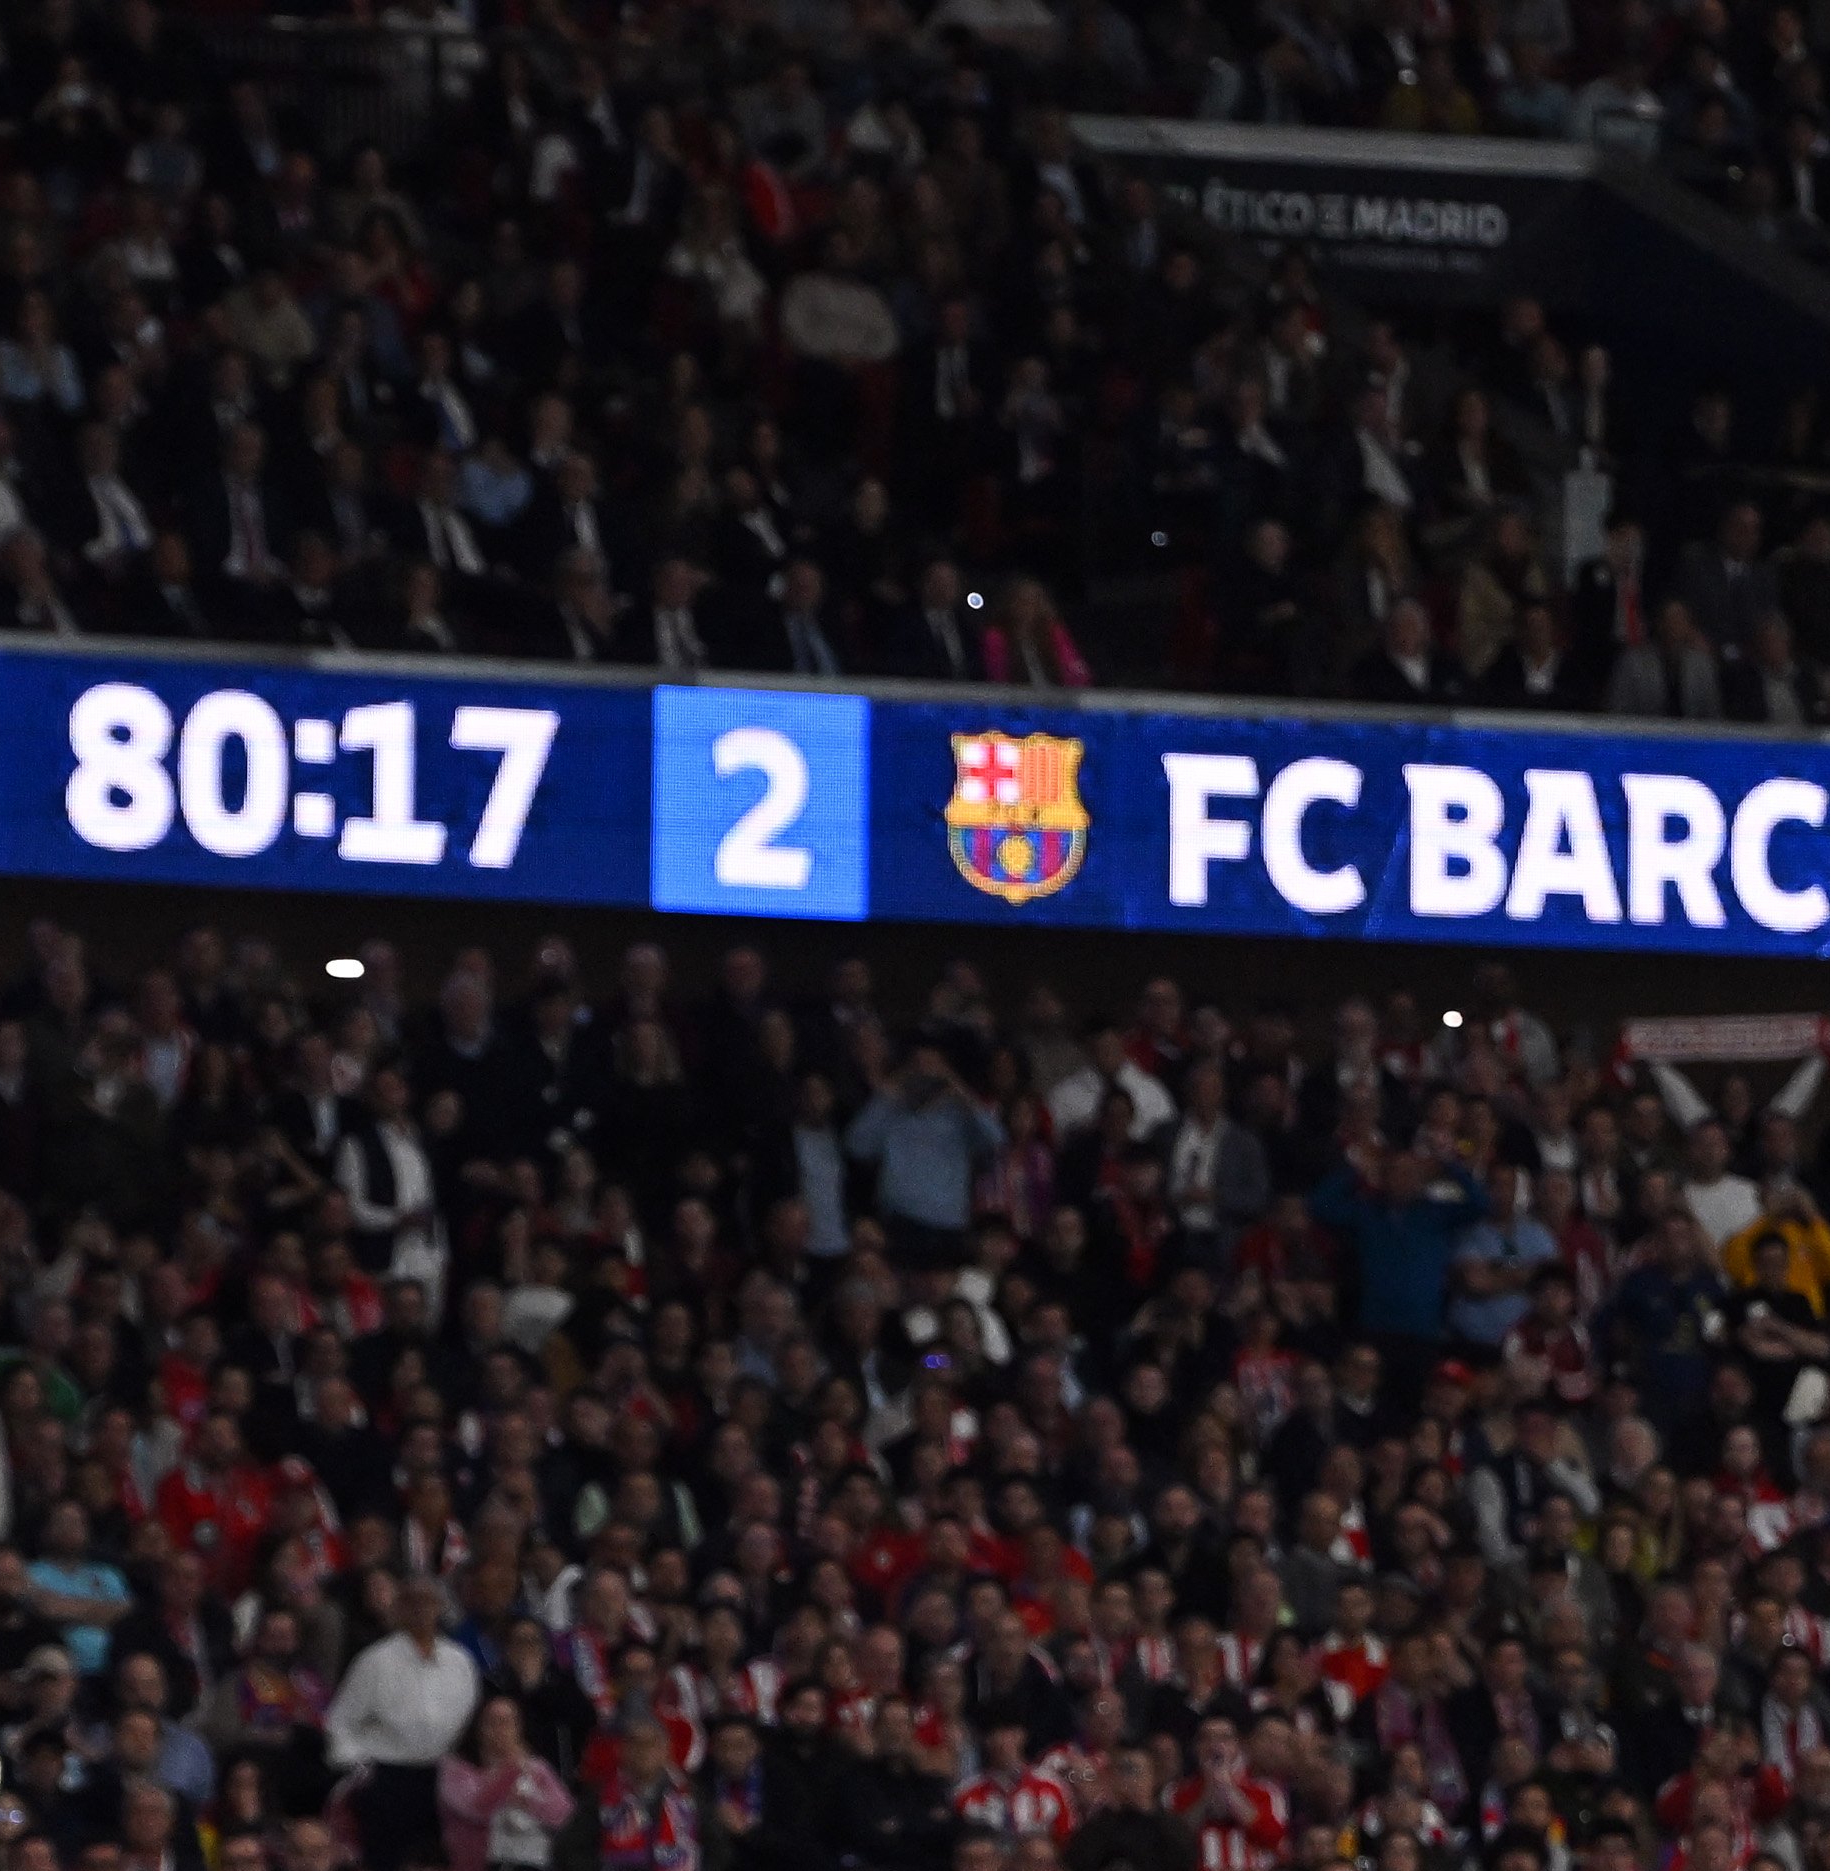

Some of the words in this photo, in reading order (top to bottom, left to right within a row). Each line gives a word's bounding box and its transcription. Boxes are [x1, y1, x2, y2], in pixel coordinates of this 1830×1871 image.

[1353, 197, 1508, 247] MADRID
[65, 681, 560, 869] 80:17
[710, 728, 811, 890] 2
[1162, 752, 1366, 914] FC
